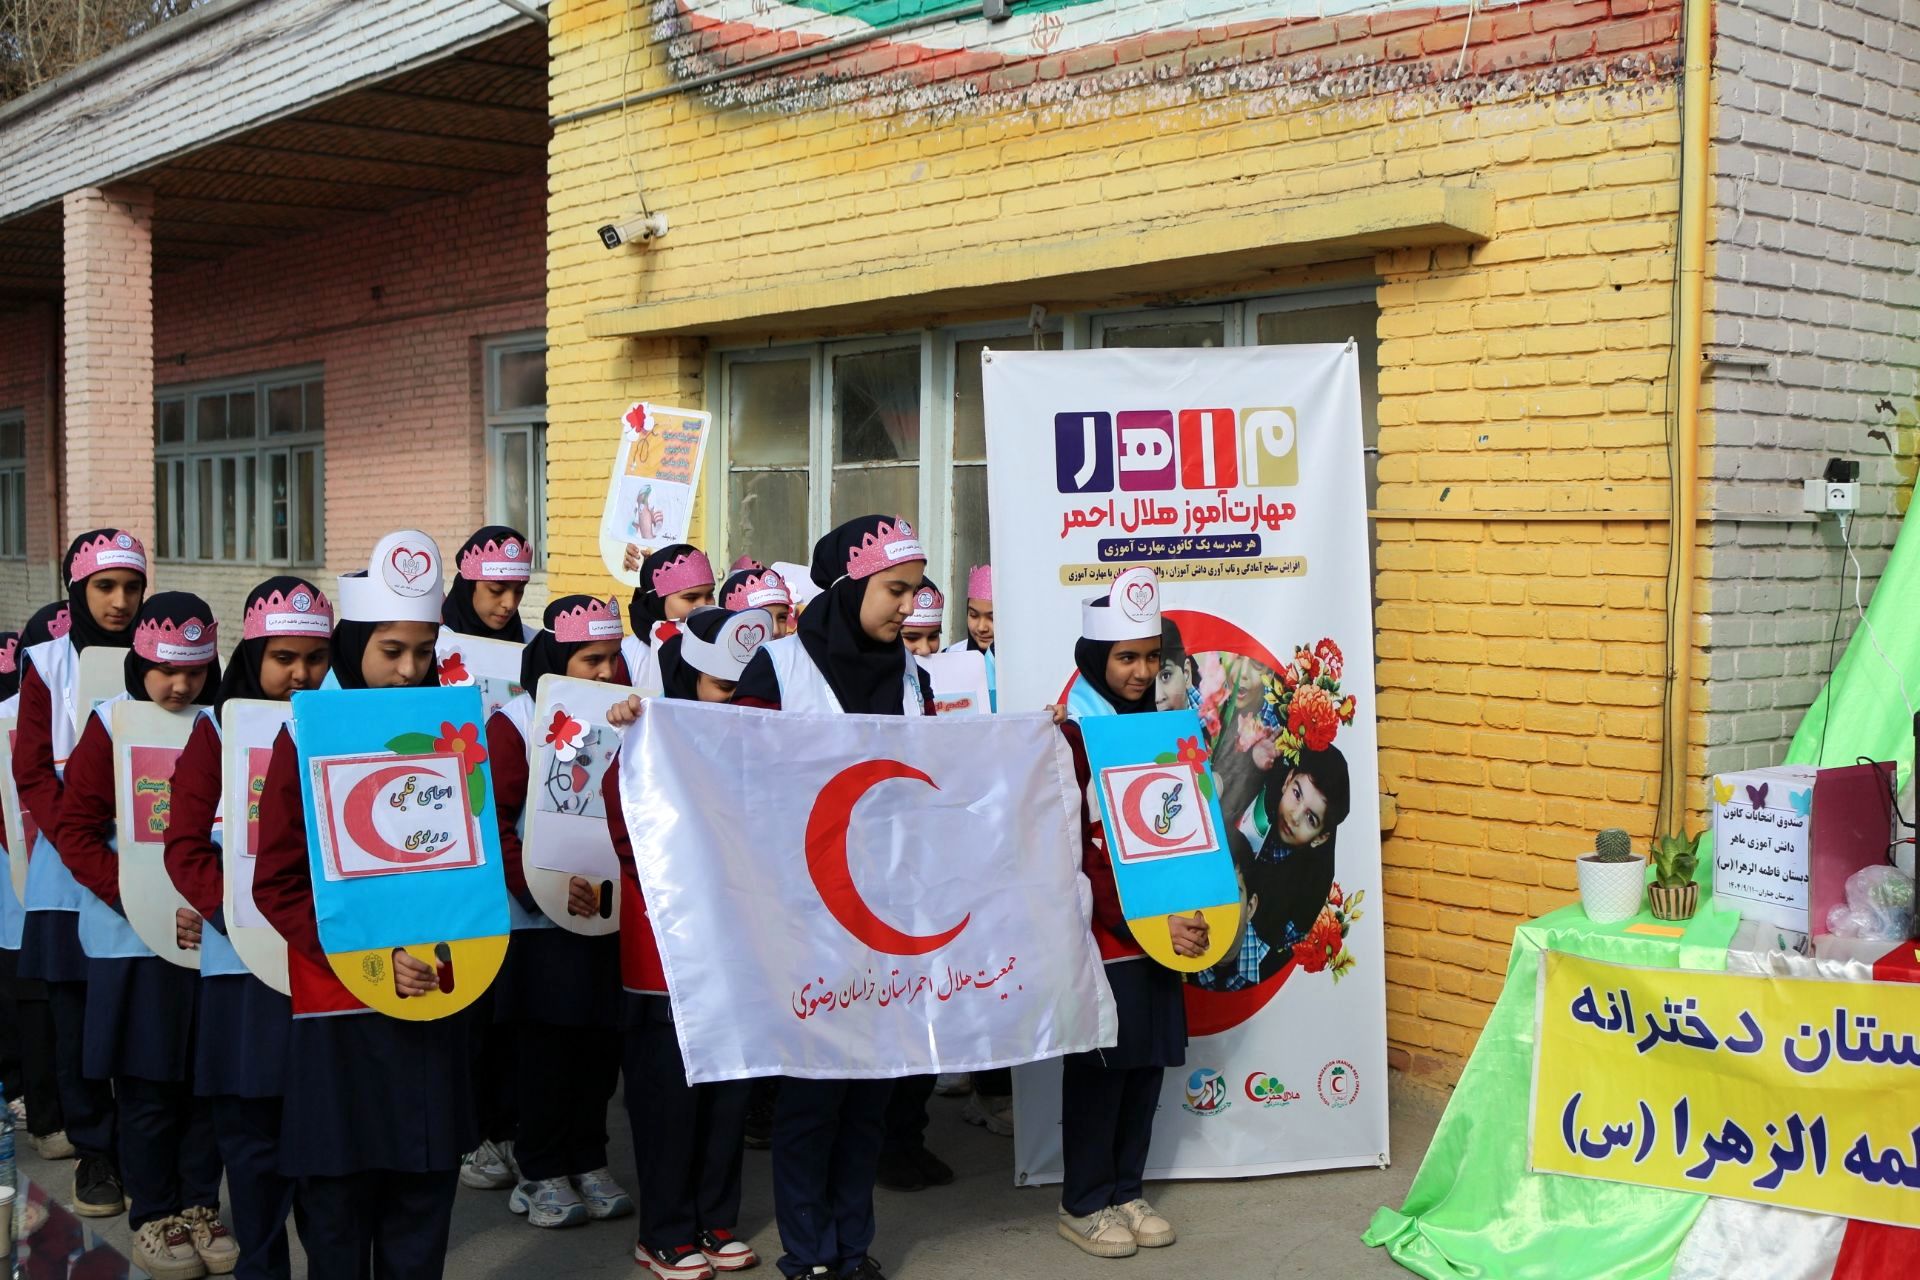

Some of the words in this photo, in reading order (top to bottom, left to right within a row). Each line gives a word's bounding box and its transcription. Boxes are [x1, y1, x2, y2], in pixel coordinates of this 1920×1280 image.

[1073, 410, 1295, 490] ماهر
[1061, 498, 1114, 539] احمر
[1120, 498, 1178, 533] هلال
[1104, 539, 1135, 558] آموزی
[1137, 541, 1166, 557] مهارت
[1168, 539, 1193, 555] کانون
[1195, 538, 1210, 553] یک
[1212, 540, 1243, 553] مدرسه
[1245, 540, 1257, 552] هر
[1068, 567, 1087, 582] آموزی
[1089, 569, 1108, 581] مهارت
[1191, 565, 1207, 577] دانش
[1207, 563, 1224, 577] آوری
[1225, 564, 1236, 575] تاب
[1241, 561, 1263, 576] آمادگی
[1264, 563, 1279, 574] سطح
[1279, 561, 1301, 574] افزایش
[389, 775, 417, 812] قلبی
[416, 785, 453, 809] احیای
[1723, 808, 1743, 820] کانون
[1745, 810, 1775, 824] انتخابات
[1776, 814, 1803, 829] صندوق
[1729, 833, 1746, 846] ماهر
[1747, 836, 1772, 851] آموزی
[1774, 841, 1795, 853] دانش
[1717, 856, 1733, 871] (س)
[1735, 859, 1757, 875] الزهرا
[1758, 864, 1781, 879] فاطمه
[1782, 871, 1809, 884] دبستان
[937, 965, 972, 1001] هلال
[973, 956, 1024, 1000] جمعیت
[839, 968, 876, 1009] خراسان
[877, 969, 911, 1007] استان
[907, 976, 933, 1004] احمر
[791, 977, 837, 1020] رضوی
[1571, 986, 1764, 1054] دخترانه
[1562, 1092, 1656, 1164] (س)
[1674, 1096, 1827, 1190] الزهرا
